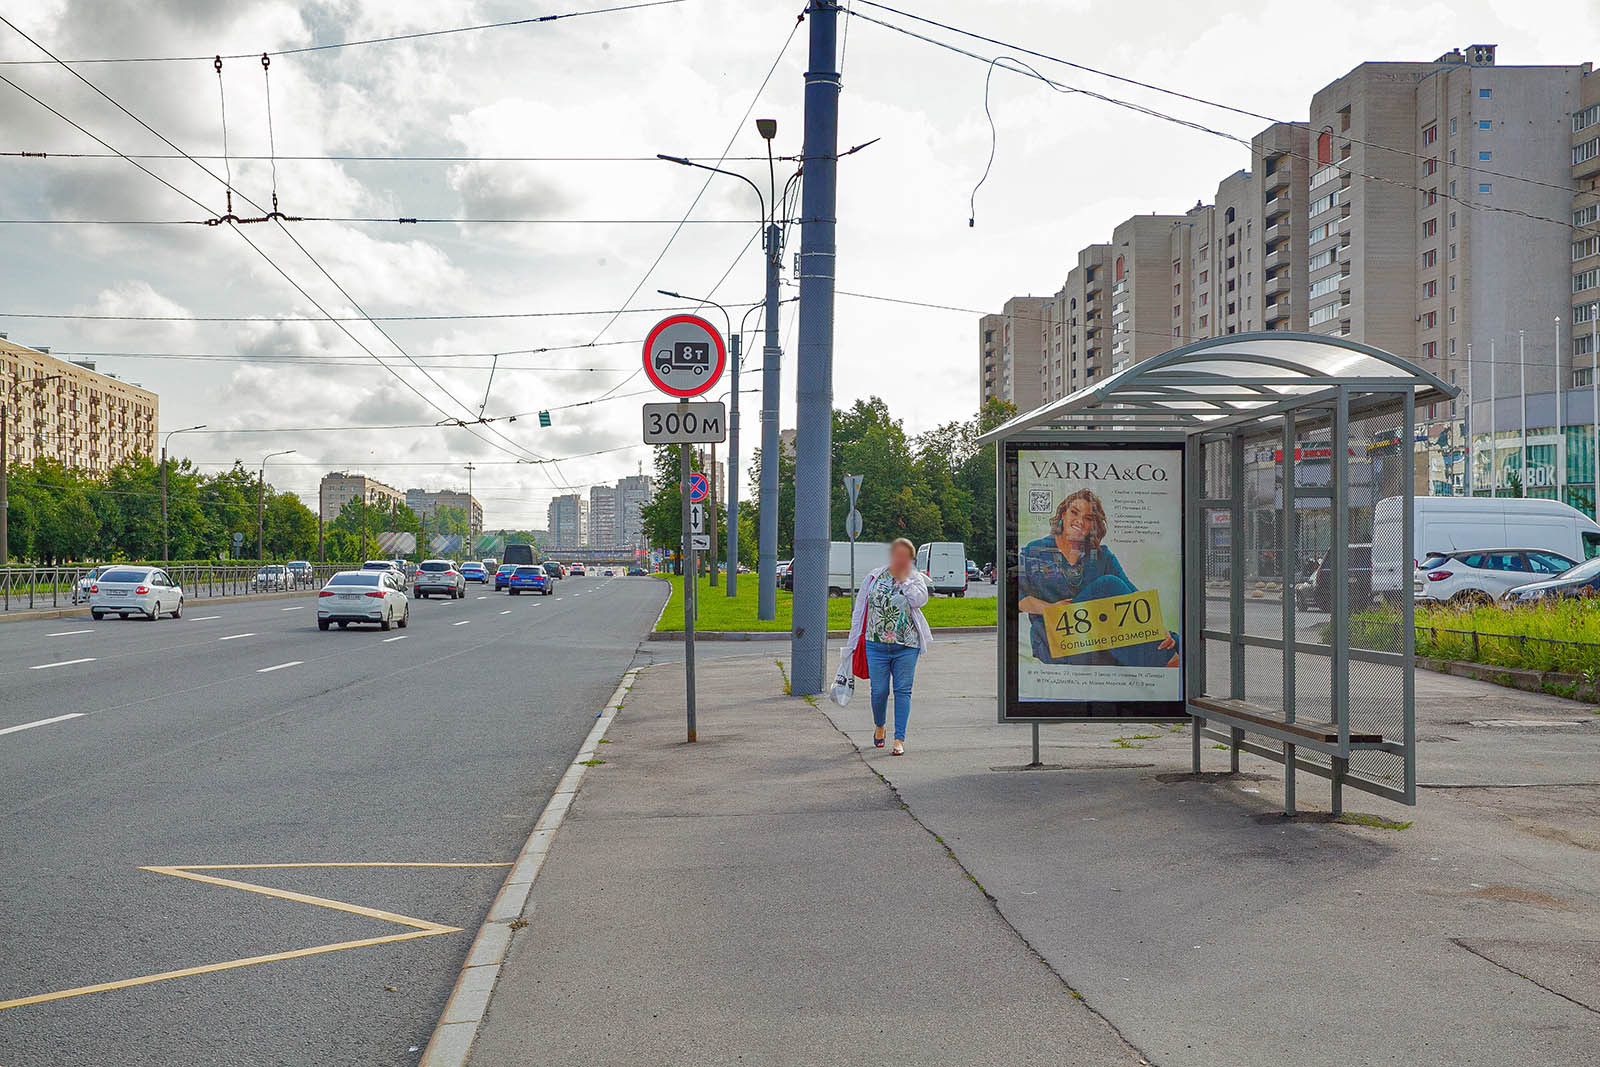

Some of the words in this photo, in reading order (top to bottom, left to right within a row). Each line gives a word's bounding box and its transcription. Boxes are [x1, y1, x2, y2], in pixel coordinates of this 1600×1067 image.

[1503, 464, 1555, 489] СВОК
[1055, 609, 1092, 636] 48
[1114, 598, 1151, 627] 70
[1060, 638, 1107, 650] большие
[1111, 629, 1159, 645] размеры
